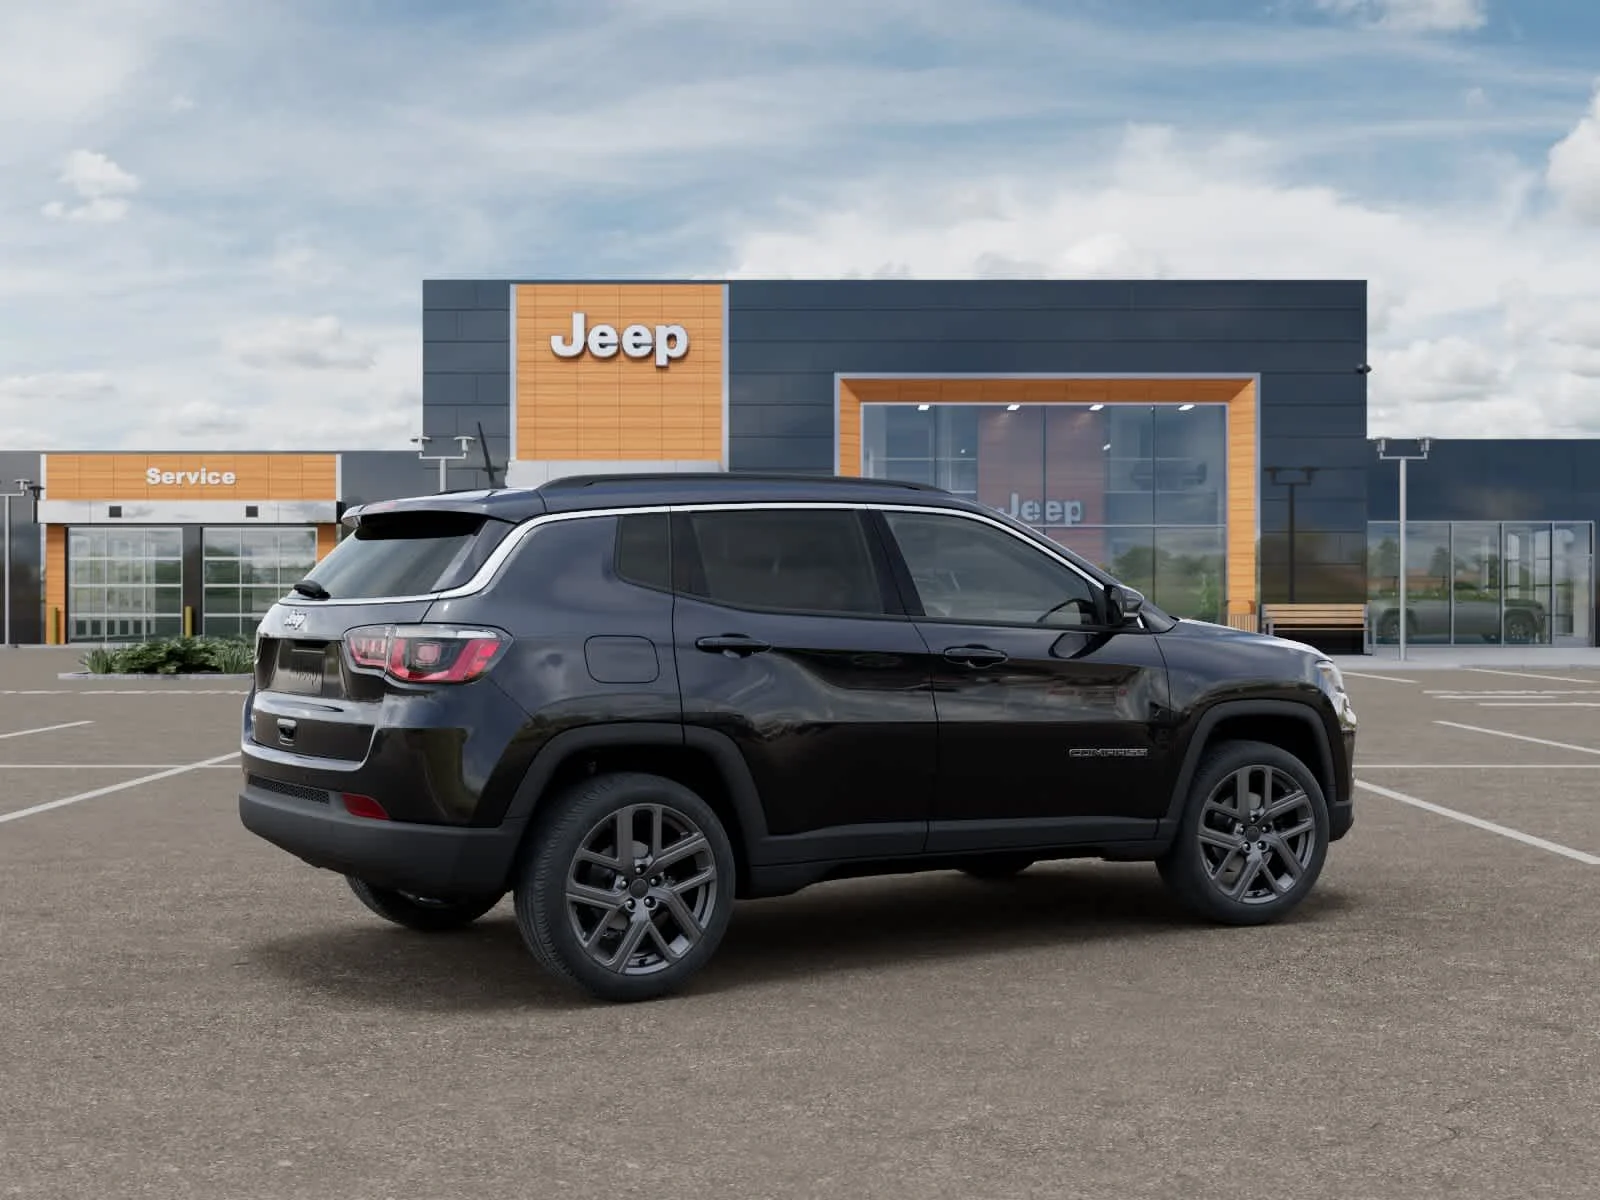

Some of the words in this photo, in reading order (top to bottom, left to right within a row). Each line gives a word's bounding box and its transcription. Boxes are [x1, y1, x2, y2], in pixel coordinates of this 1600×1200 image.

[550, 311, 689, 367] Jeep
[146, 467, 237, 486] Service
[999, 493, 1082, 526] Jeep
